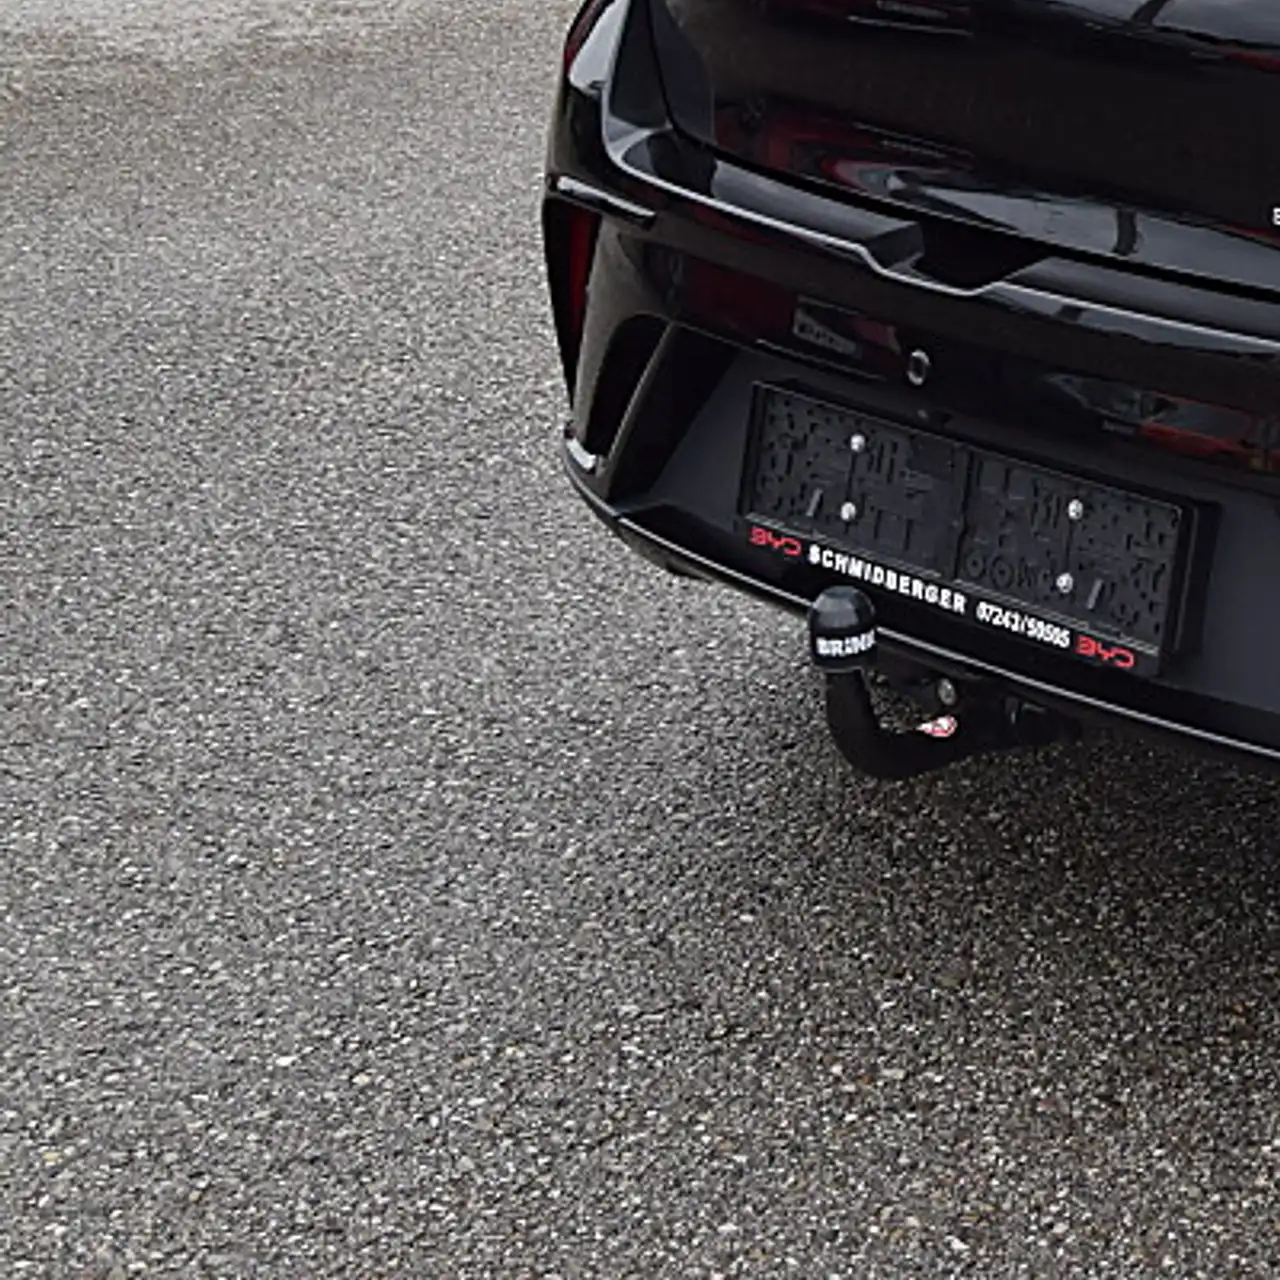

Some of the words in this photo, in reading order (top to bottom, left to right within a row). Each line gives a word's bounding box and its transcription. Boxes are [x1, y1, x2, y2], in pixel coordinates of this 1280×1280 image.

[750, 525, 801, 557] BYD
[808, 543, 967, 615] SCHMIDBERGER
[1076, 634, 1135, 669] BYD
